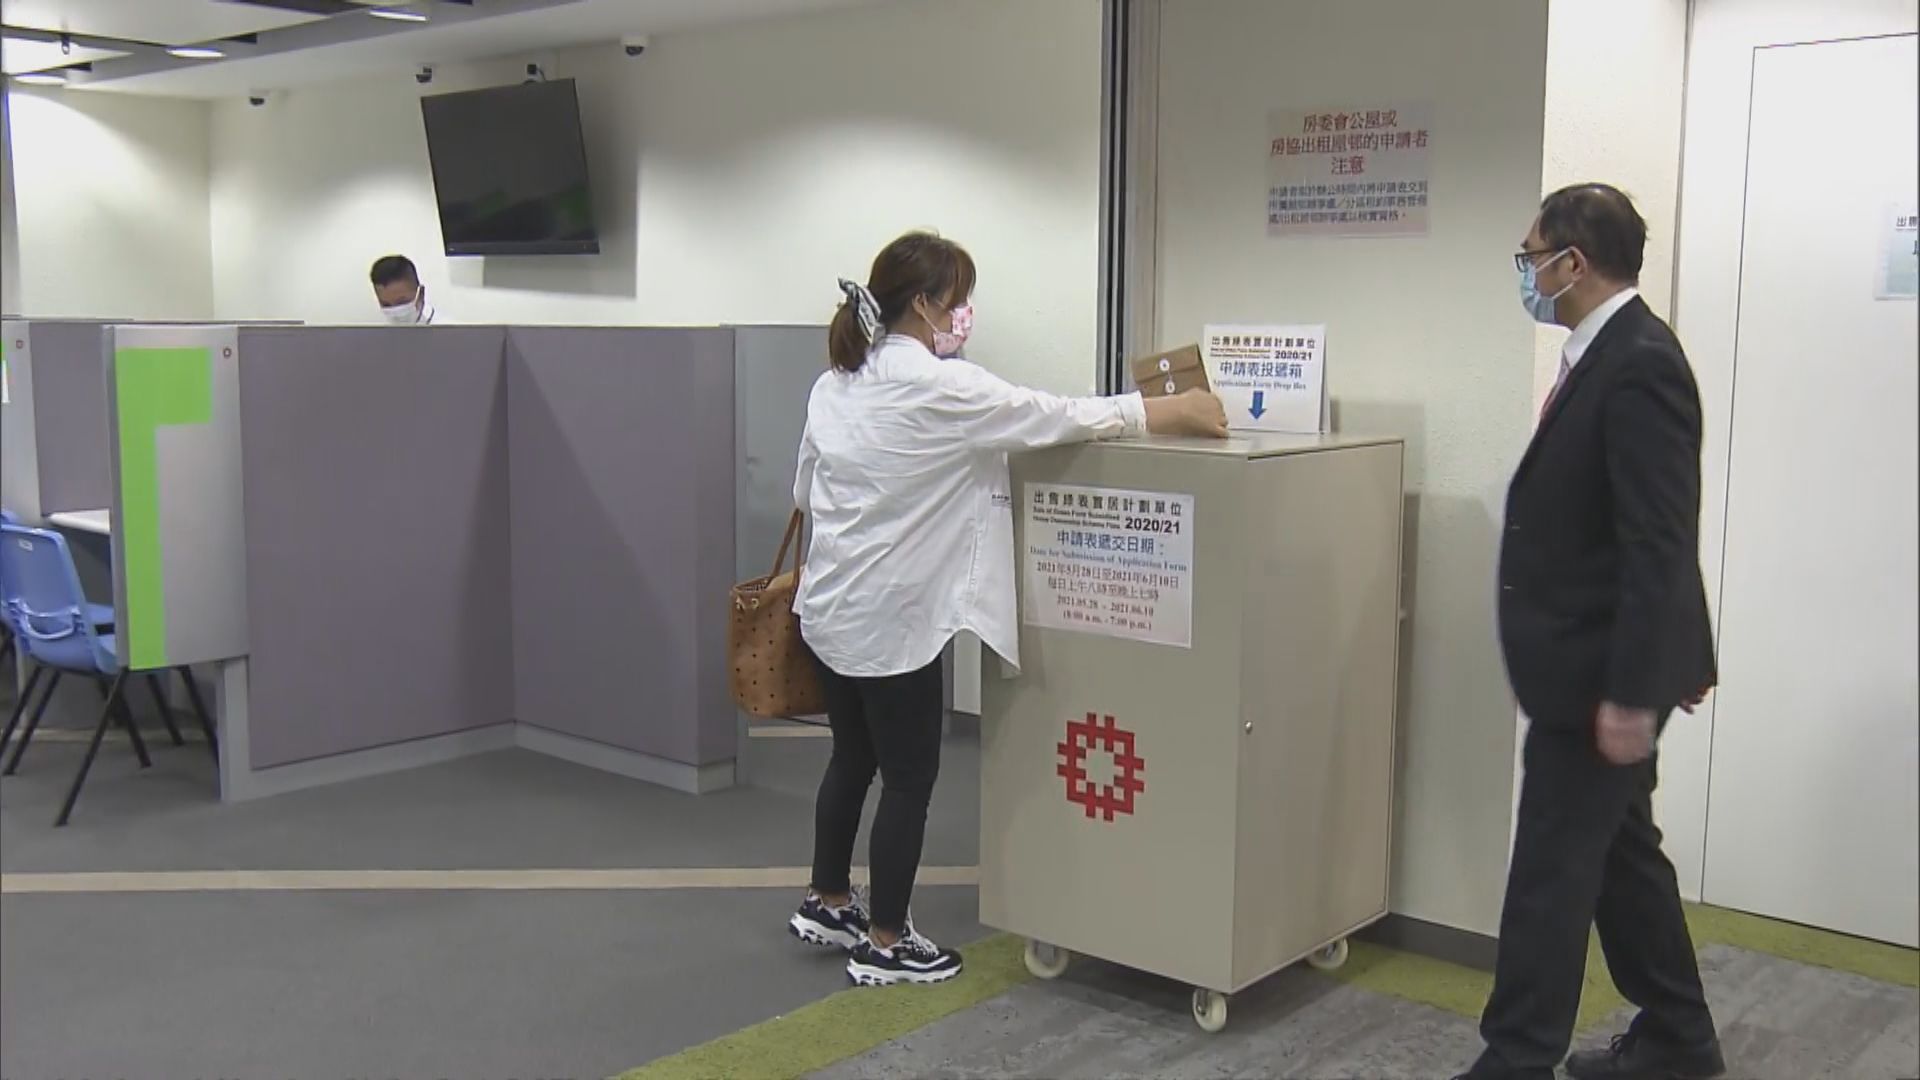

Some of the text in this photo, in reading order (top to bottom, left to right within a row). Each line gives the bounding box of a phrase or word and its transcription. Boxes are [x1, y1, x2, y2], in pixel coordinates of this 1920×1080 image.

[1303, 110, 1397, 133] 房委會公屋或
[1271, 130, 1428, 156] 房協出租屋邨的申請者
[1331, 155, 1364, 175] 注意
[1275, 350, 1312, 360] 2020/21
[1219, 361, 1303, 378] 申請表投遞箱
[1125, 517, 1181, 534] 2020/21
[1036, 561, 1179, 588] 2021年5月28日至2021年6月10日
[1048, 577, 1160, 602] 每日上午八時至晚上七時
